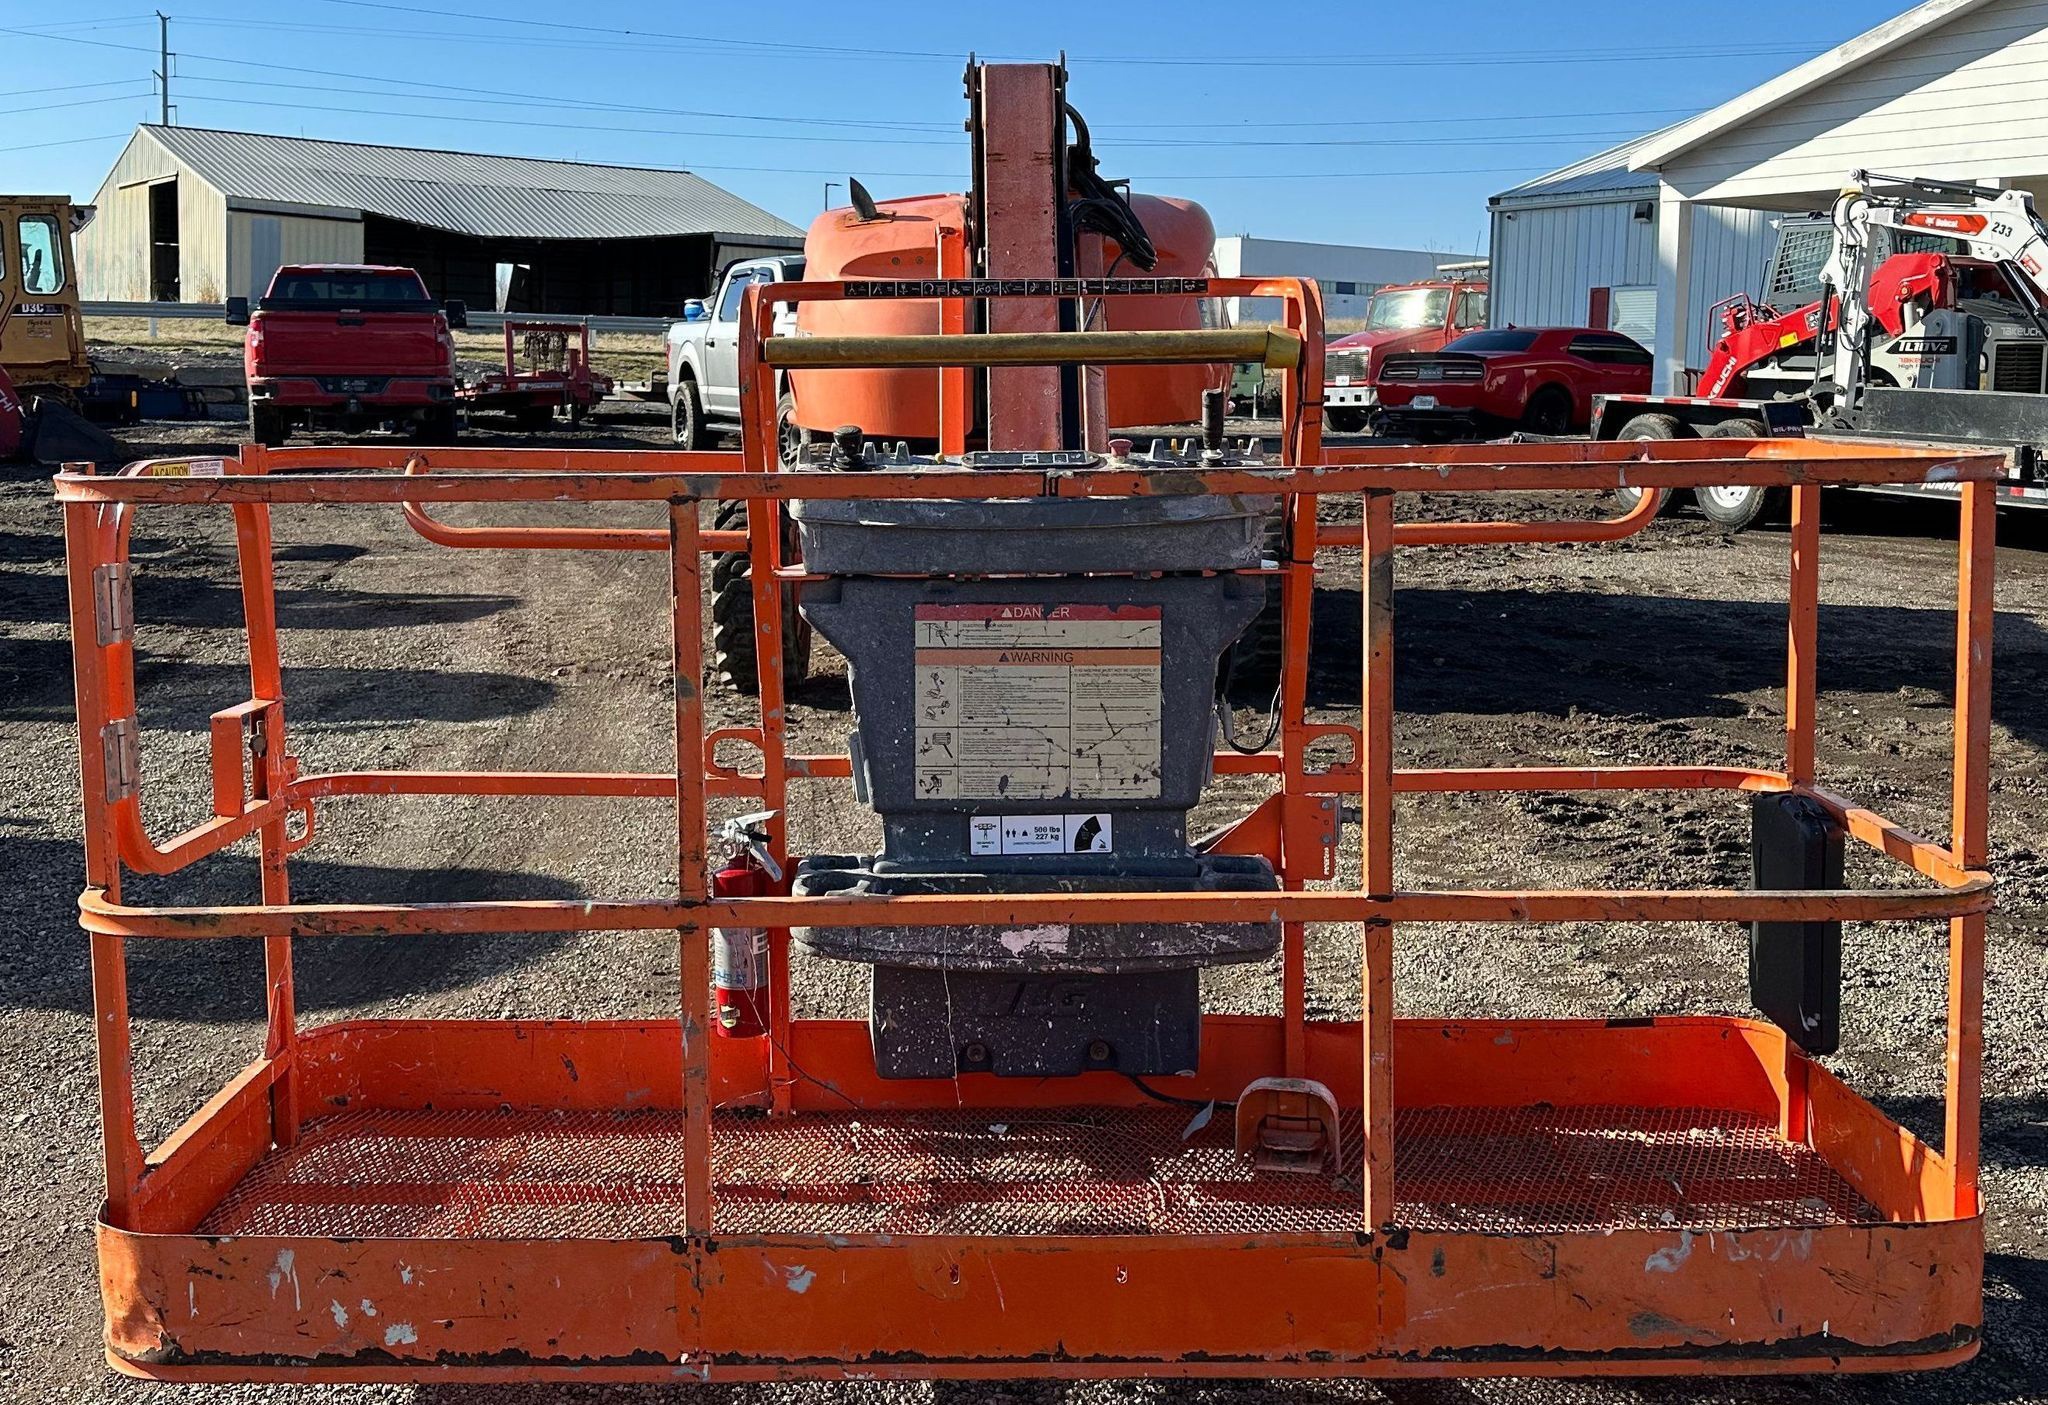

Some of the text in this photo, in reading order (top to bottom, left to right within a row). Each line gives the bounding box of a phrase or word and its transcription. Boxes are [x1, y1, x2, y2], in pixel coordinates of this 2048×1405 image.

[1991, 221, 2013, 238] 233
[21, 303, 44, 313] D3C
[2000, 326, 2042, 337] TAKEUCH
[1707, 355, 1738, 400] KEUCHI
[1013, 607, 1071, 618] DANER
[1010, 651, 1074, 663] WARNING
[1050, 833, 1060, 841] kg
